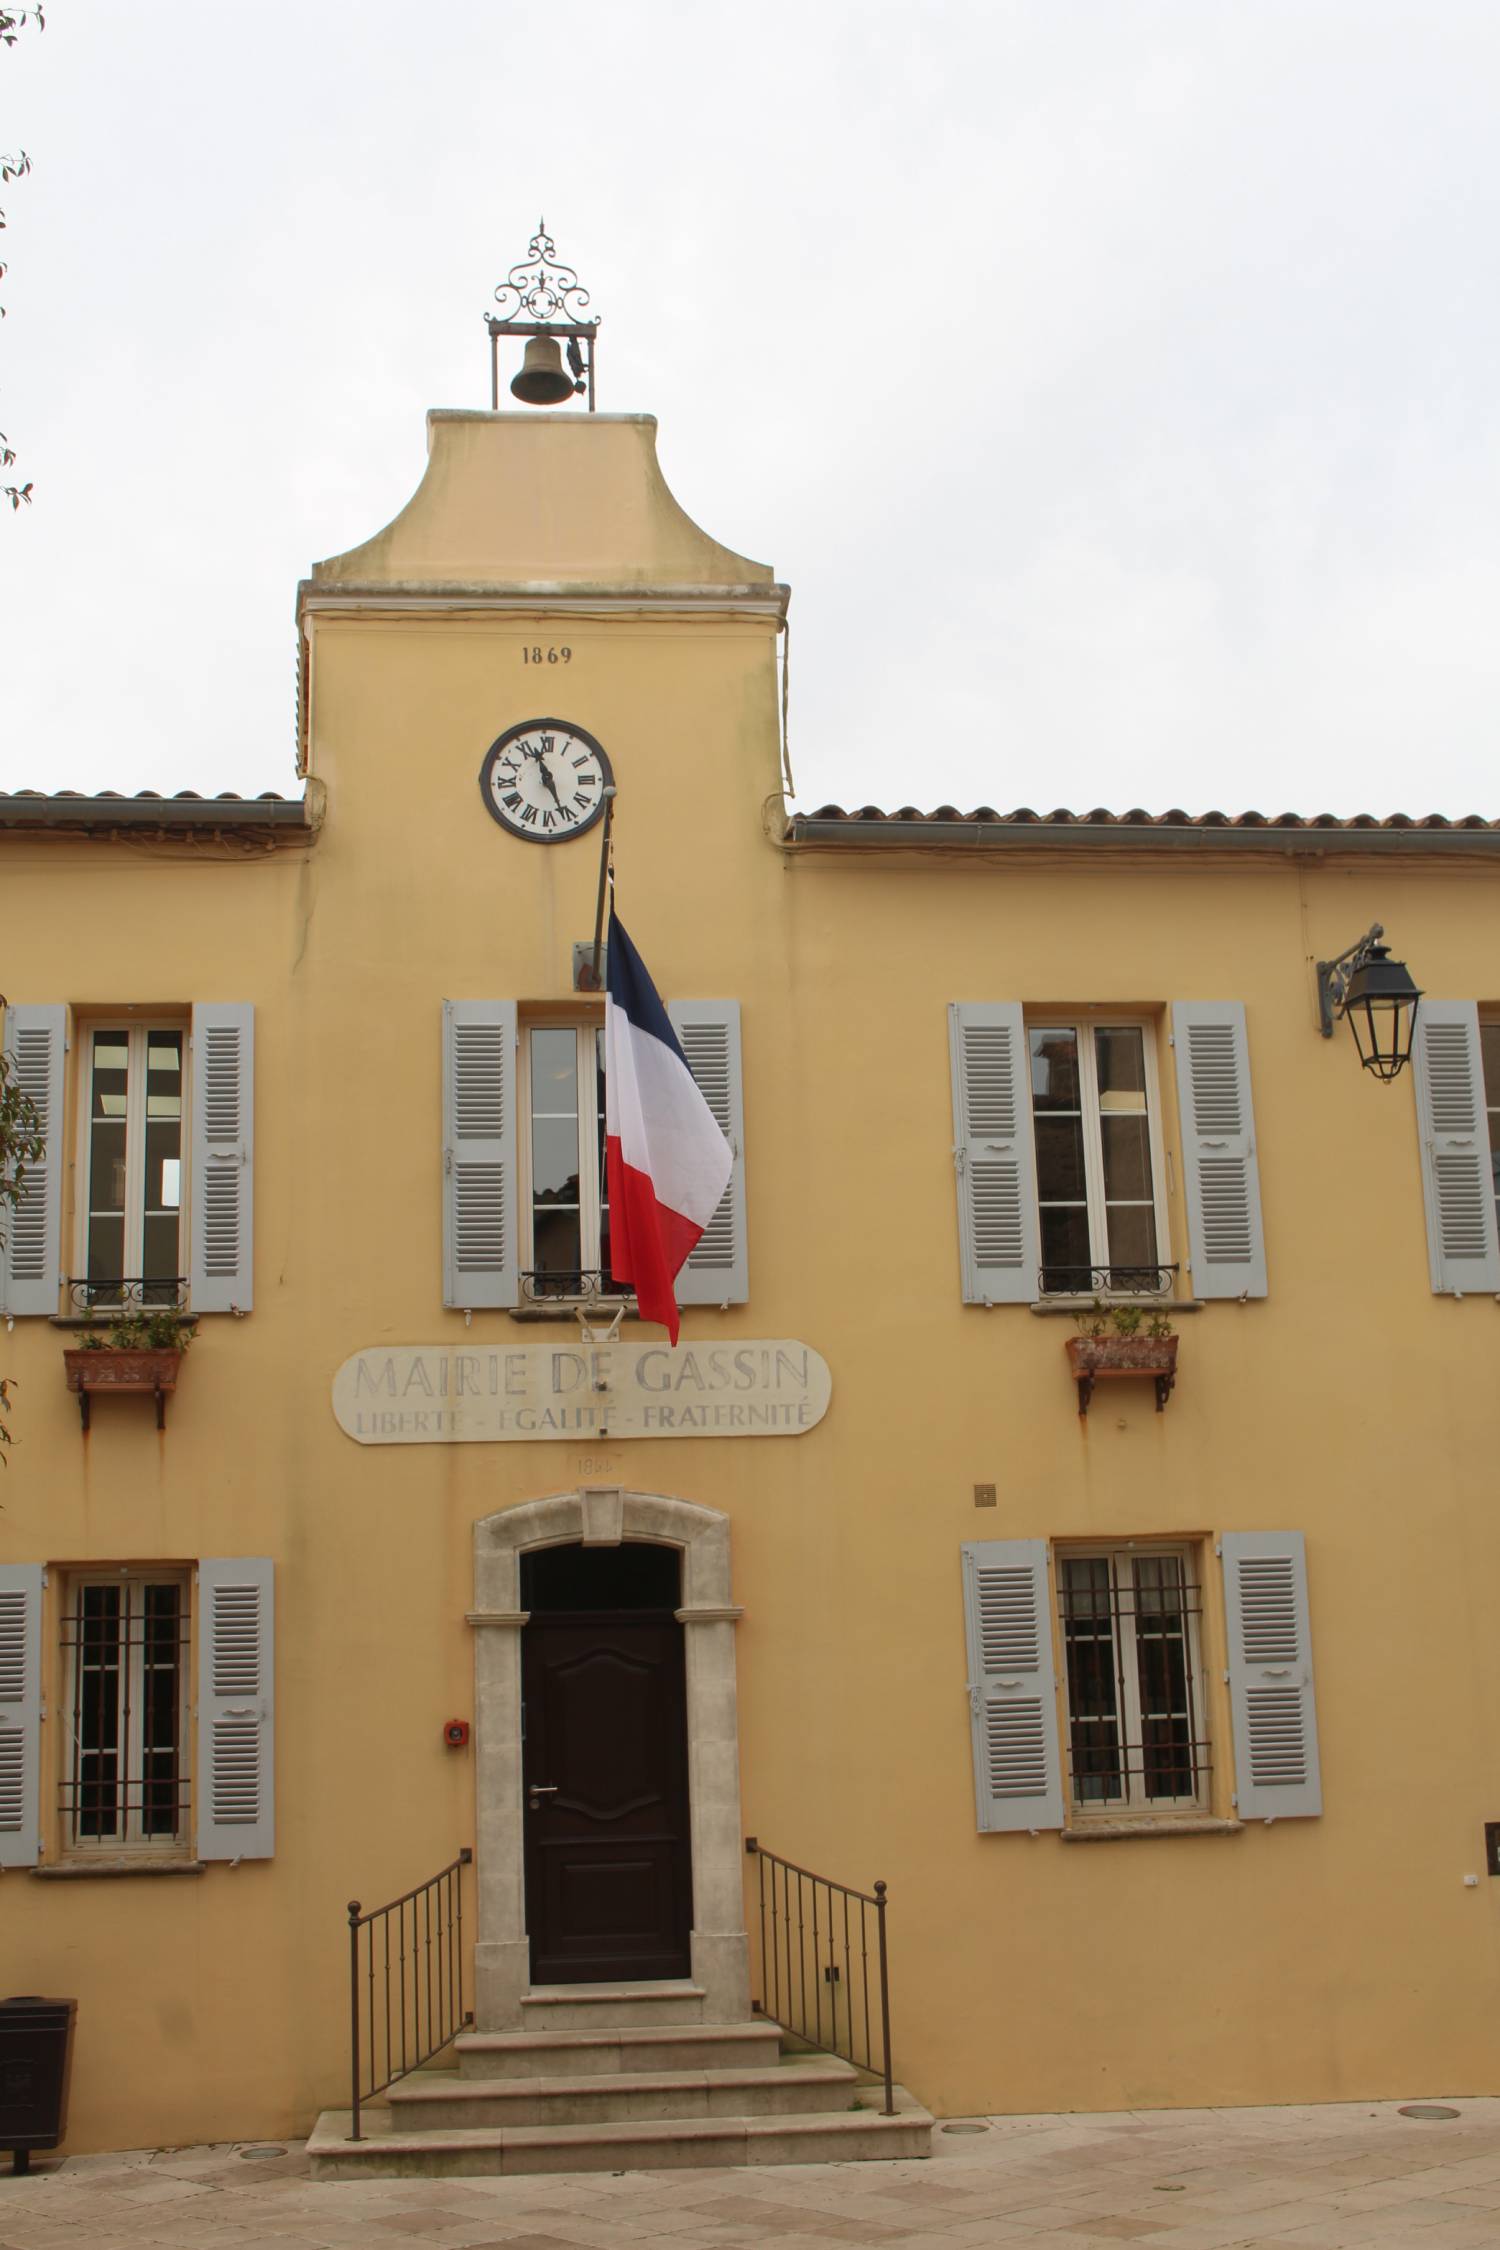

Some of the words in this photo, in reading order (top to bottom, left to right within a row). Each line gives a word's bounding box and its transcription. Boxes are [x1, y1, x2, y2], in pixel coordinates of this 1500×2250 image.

[522, 646, 572, 665] 1869
[561, 741, 571, 756] I
[502, 757, 521, 773] X
[571, 755, 589, 768] II
[497, 775, 516, 789] IX
[578, 774, 596, 786] III
[502, 791, 524, 813] VIII
[573, 791, 592, 810] IV
[520, 803, 540, 825] VII
[542, 811, 558, 827] VI
[354, 1354, 527, 1398] MAIRIE
[551, 1351, 613, 1394] DE
[635, 1349, 808, 1392] GASSIN
[355, 1402, 464, 1435] LIBERTÉ
[498, 1400, 617, 1431] ÉGALITÉ
[643, 1396, 812, 1428] FRATERNITÉ
